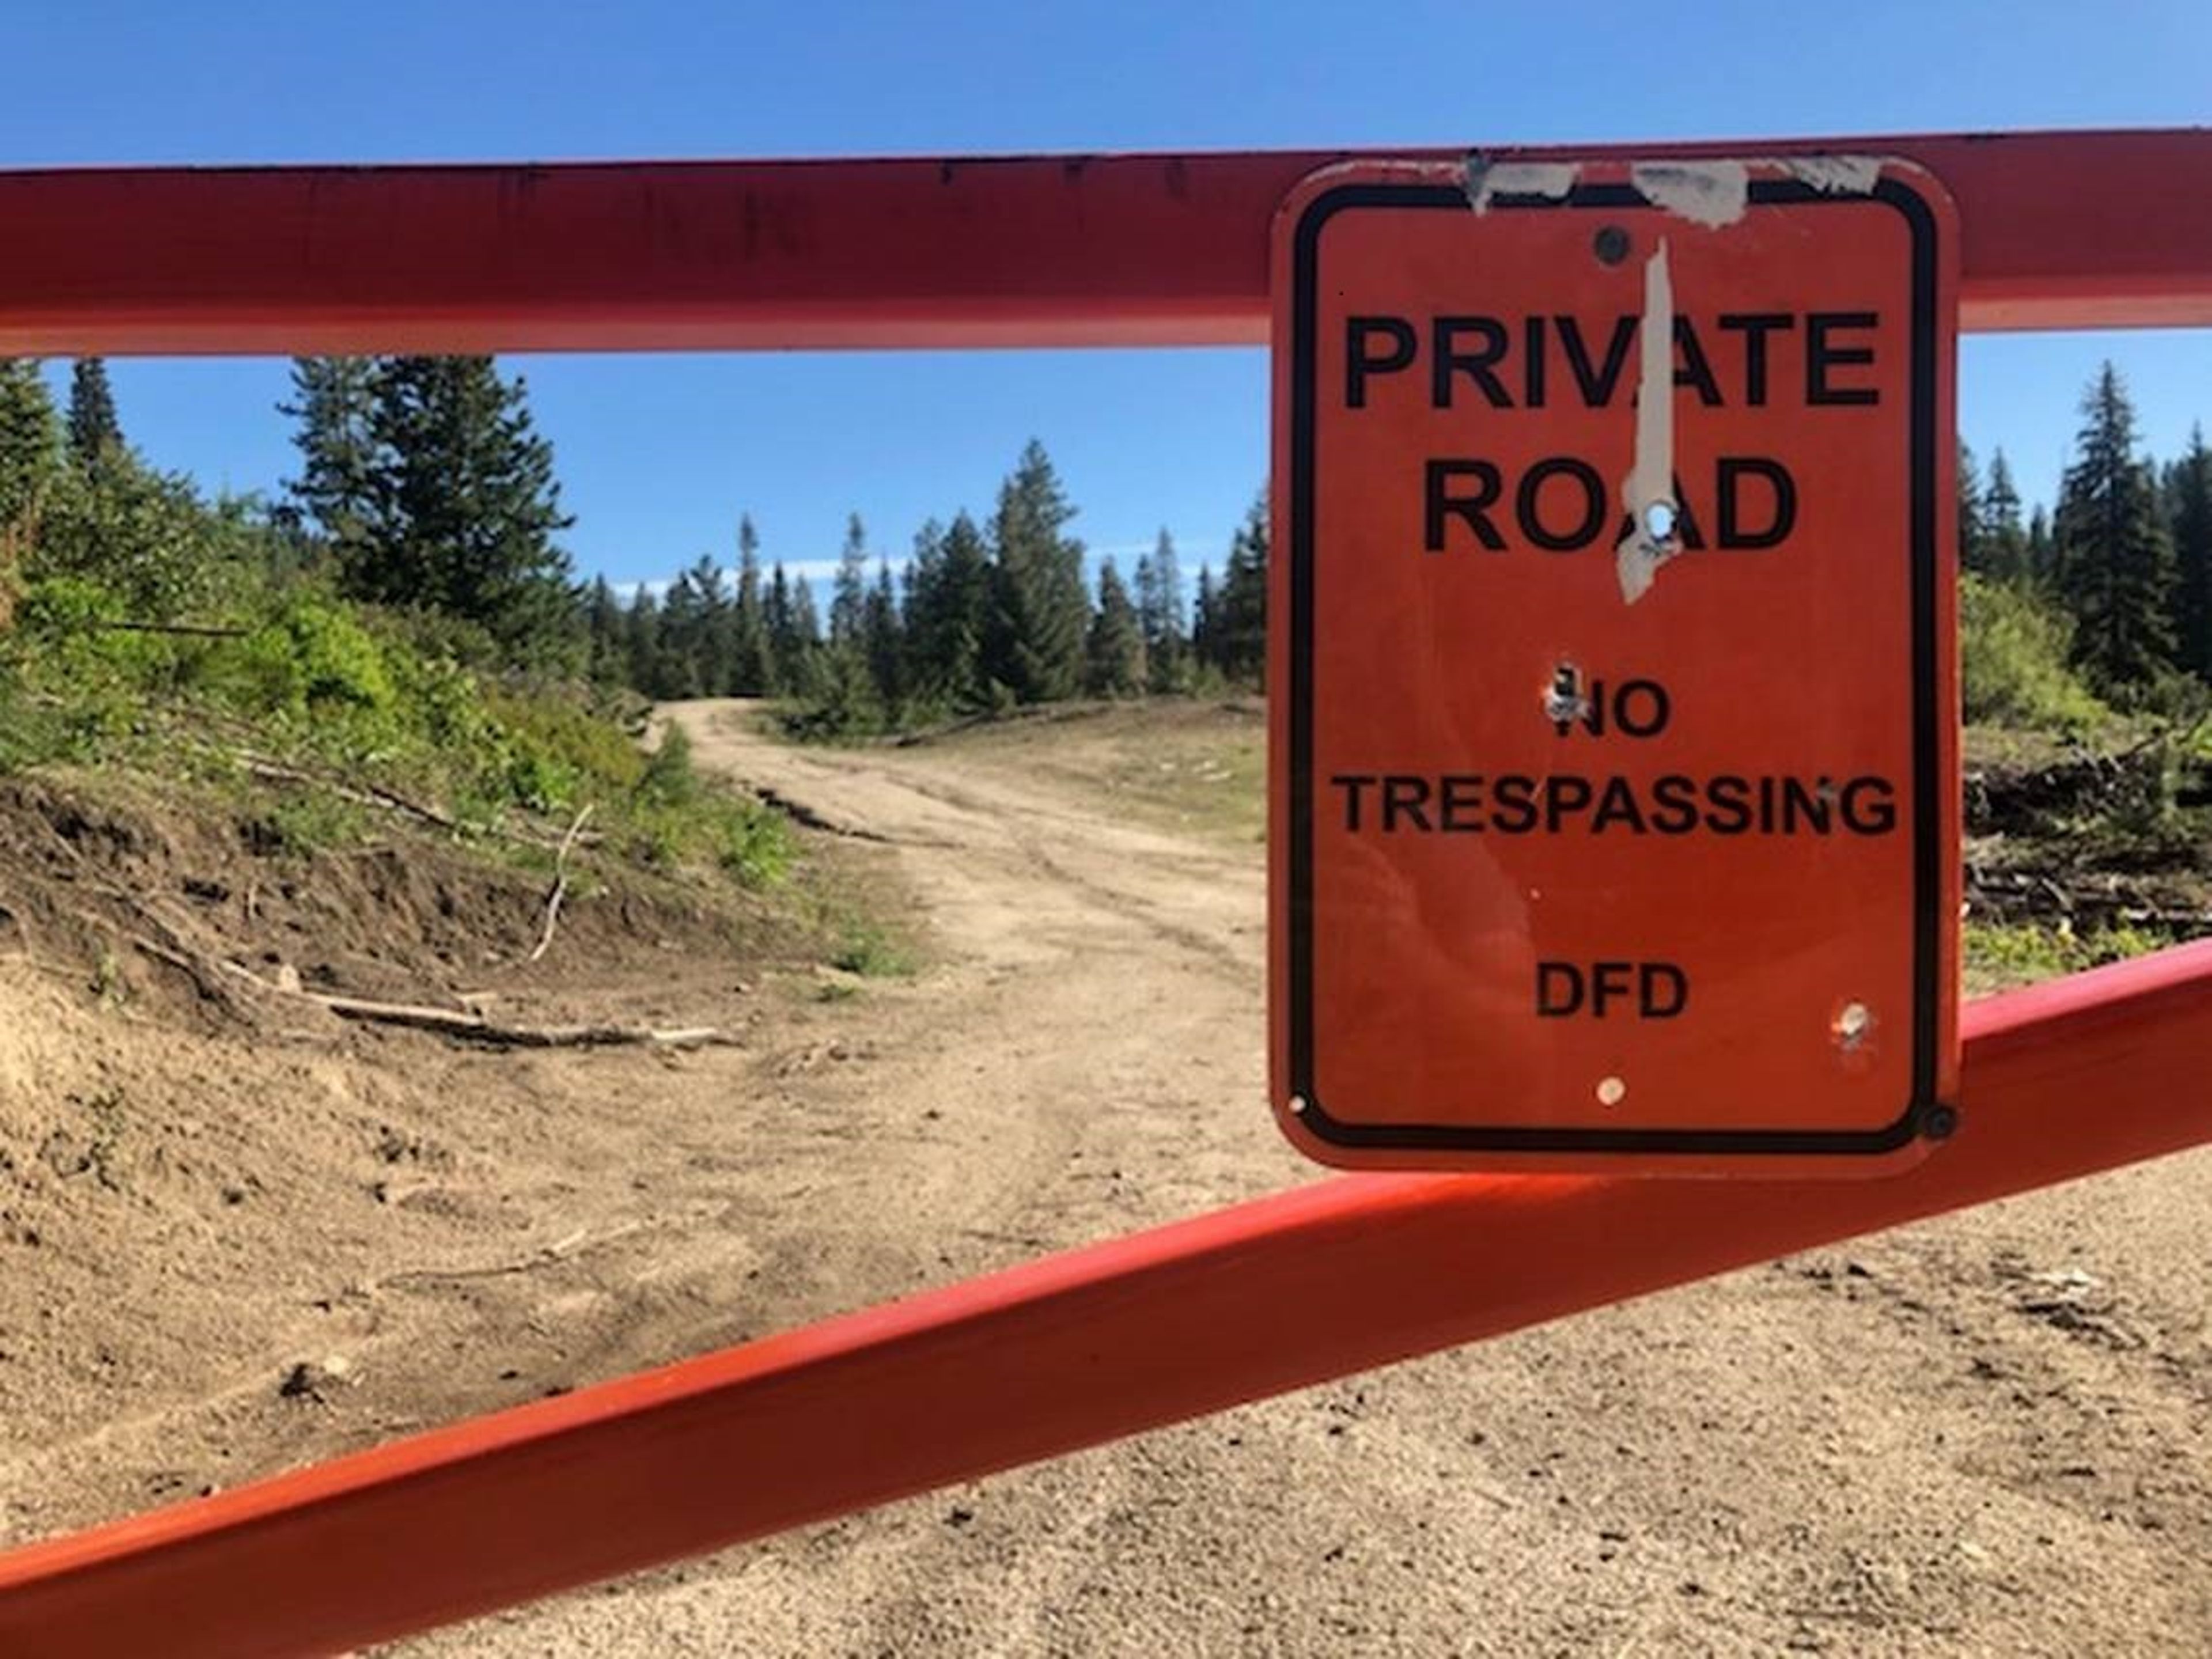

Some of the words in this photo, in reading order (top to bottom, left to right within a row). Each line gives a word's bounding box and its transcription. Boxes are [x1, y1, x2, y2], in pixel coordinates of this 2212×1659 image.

[1344, 310, 1880, 410] PRIVATE
[1556, 679, 1670, 738] NO
[1331, 774, 1896, 836] TRESPASSING
[1537, 961, 1687, 1018] DFD
